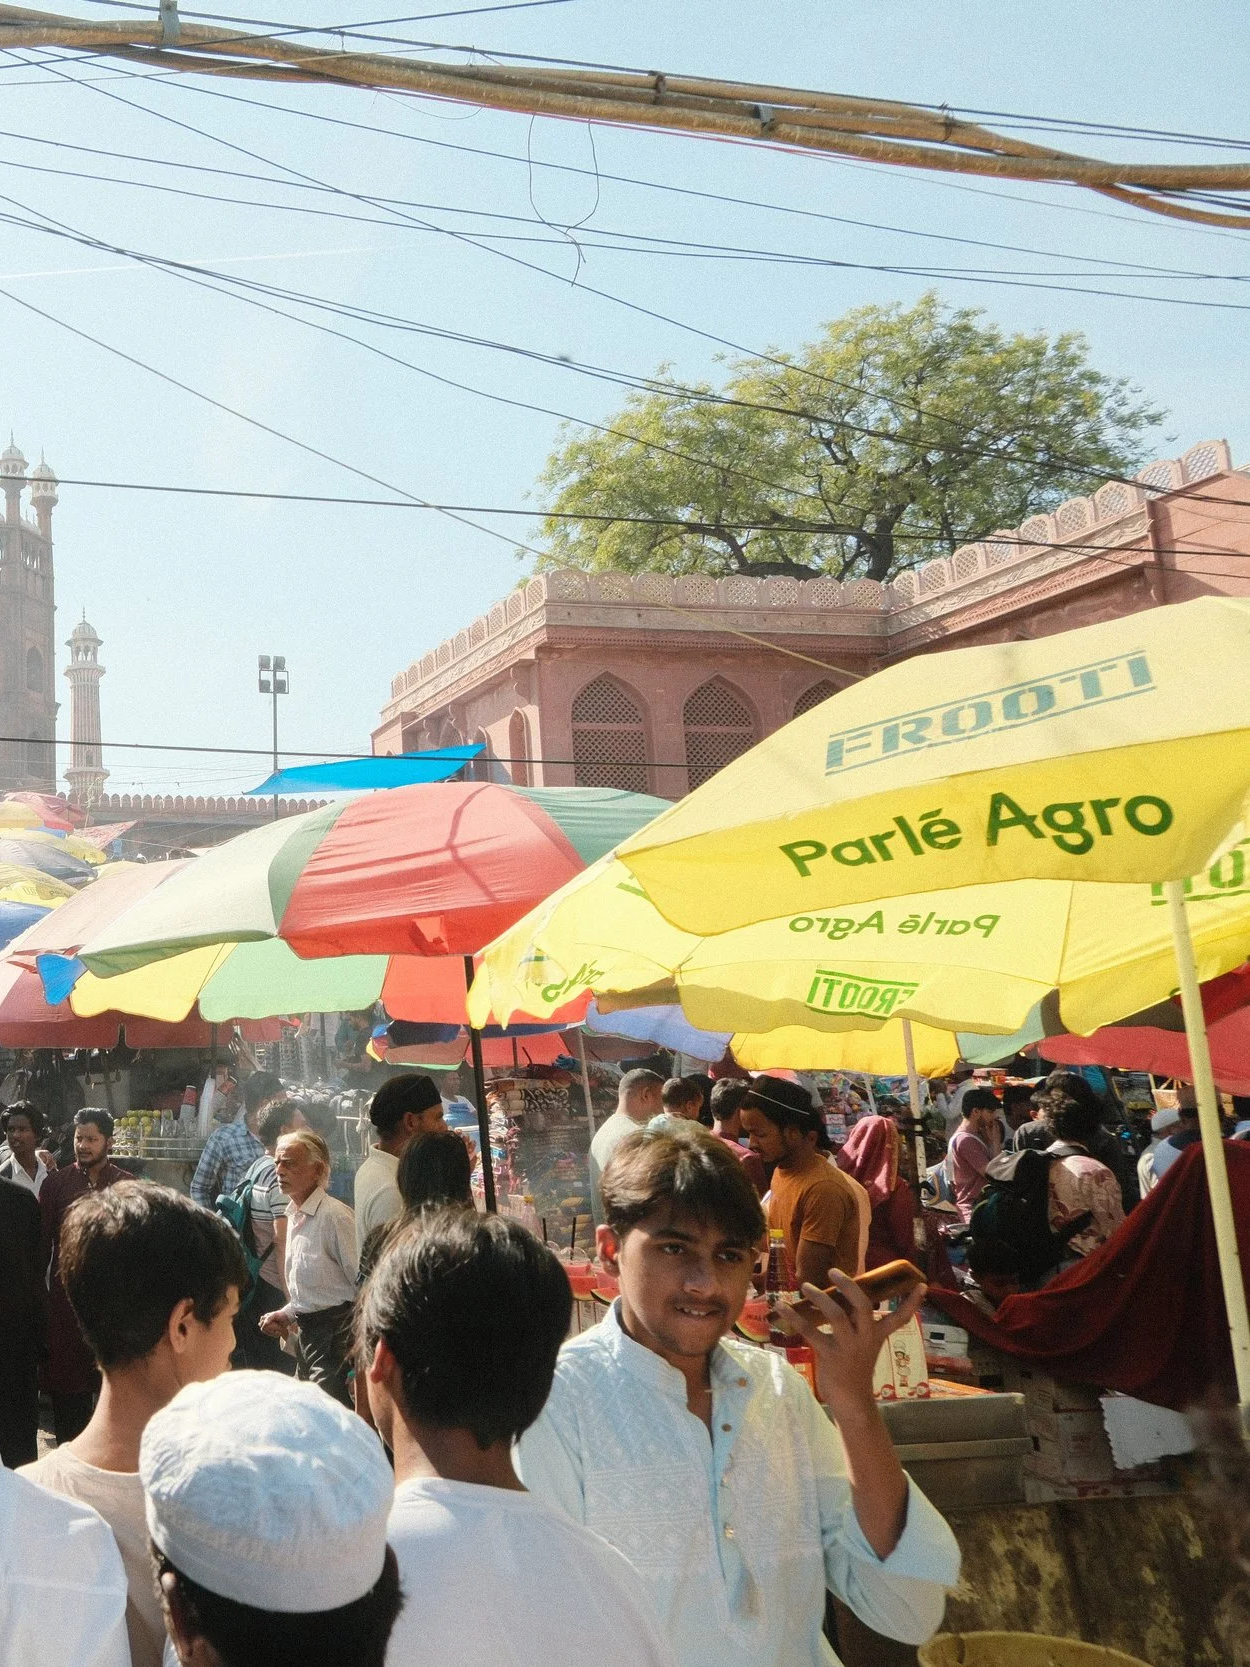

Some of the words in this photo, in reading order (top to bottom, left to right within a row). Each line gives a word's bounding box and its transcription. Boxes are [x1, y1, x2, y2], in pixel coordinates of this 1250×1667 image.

[826, 656, 1152, 769] FROOTI
[778, 808, 962, 877] Parlé
[986, 792, 1173, 855] Agro
